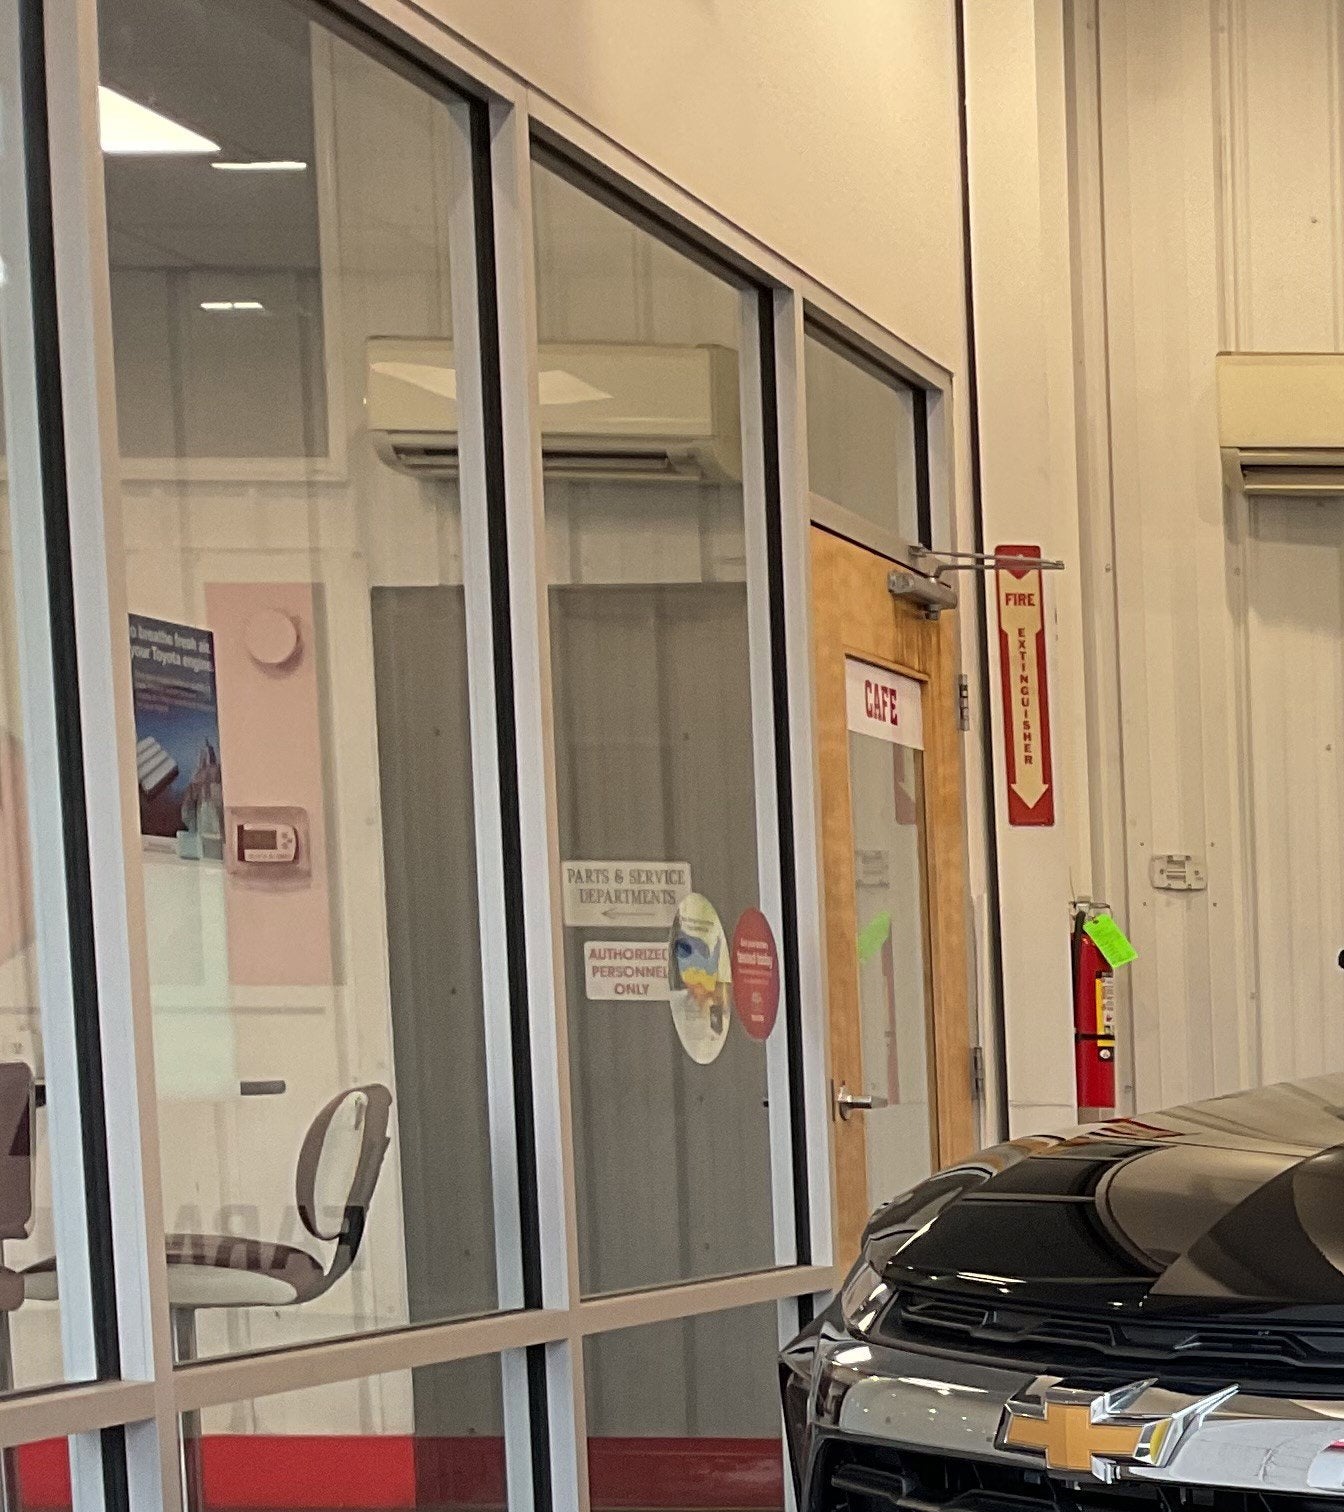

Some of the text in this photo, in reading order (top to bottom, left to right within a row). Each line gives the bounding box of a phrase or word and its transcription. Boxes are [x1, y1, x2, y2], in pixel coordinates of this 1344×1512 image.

[1005, 592, 1036, 607] FIRE
[151, 646, 182, 666] Toyota
[864, 679, 898, 726] CAFE
[1016, 627, 1034, 765] EXTINGUISHER
[567, 868, 686, 886] PARTS & SERVICE
[579, 888, 676, 906] DEPARTMENTS
[614, 983, 650, 997] ONLY
